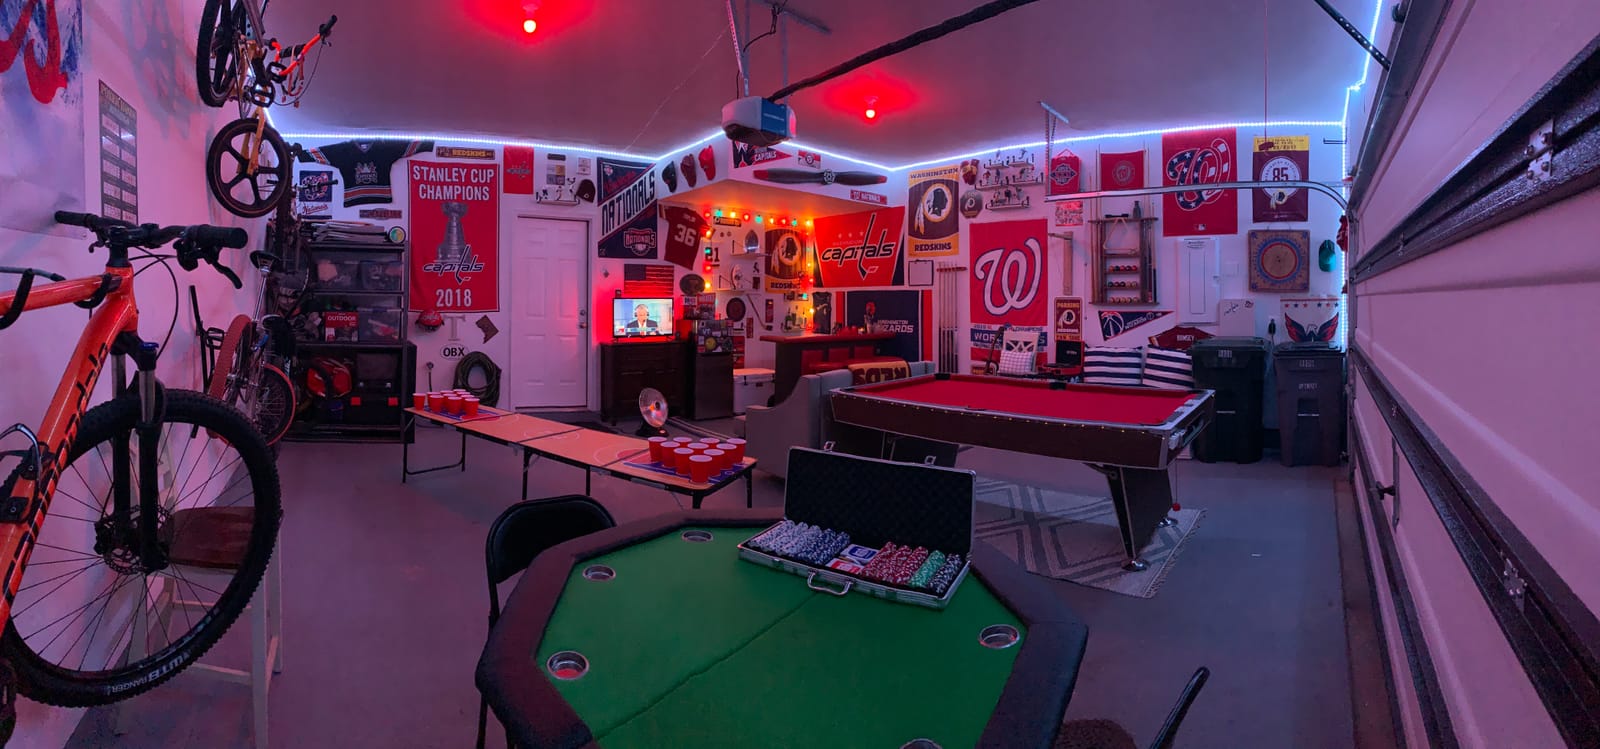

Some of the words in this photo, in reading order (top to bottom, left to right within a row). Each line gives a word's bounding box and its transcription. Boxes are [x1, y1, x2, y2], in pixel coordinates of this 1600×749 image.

[755, 151, 776, 161] CAPITALS
[413, 165, 467, 183] STANLEY
[470, 168, 494, 183] CUP
[1272, 167, 1289, 181] 85
[419, 183, 490, 201] CHAMPIONS
[602, 170, 655, 236] NATIONALS
[625, 234, 655, 246] NATIONALS
[674, 223, 697, 247] 36
[821, 212, 896, 280] capitals
[914, 242, 952, 251] REDSKINS
[423, 244, 485, 285] capitals
[436, 288, 472, 307] 2018
[880, 324, 914, 333] ZARDS
[974, 333, 1002, 344] WOR
[443, 347, 465, 357] OBX
[148, 655, 184, 682] WTB
[112, 675, 147, 694] RANGER
